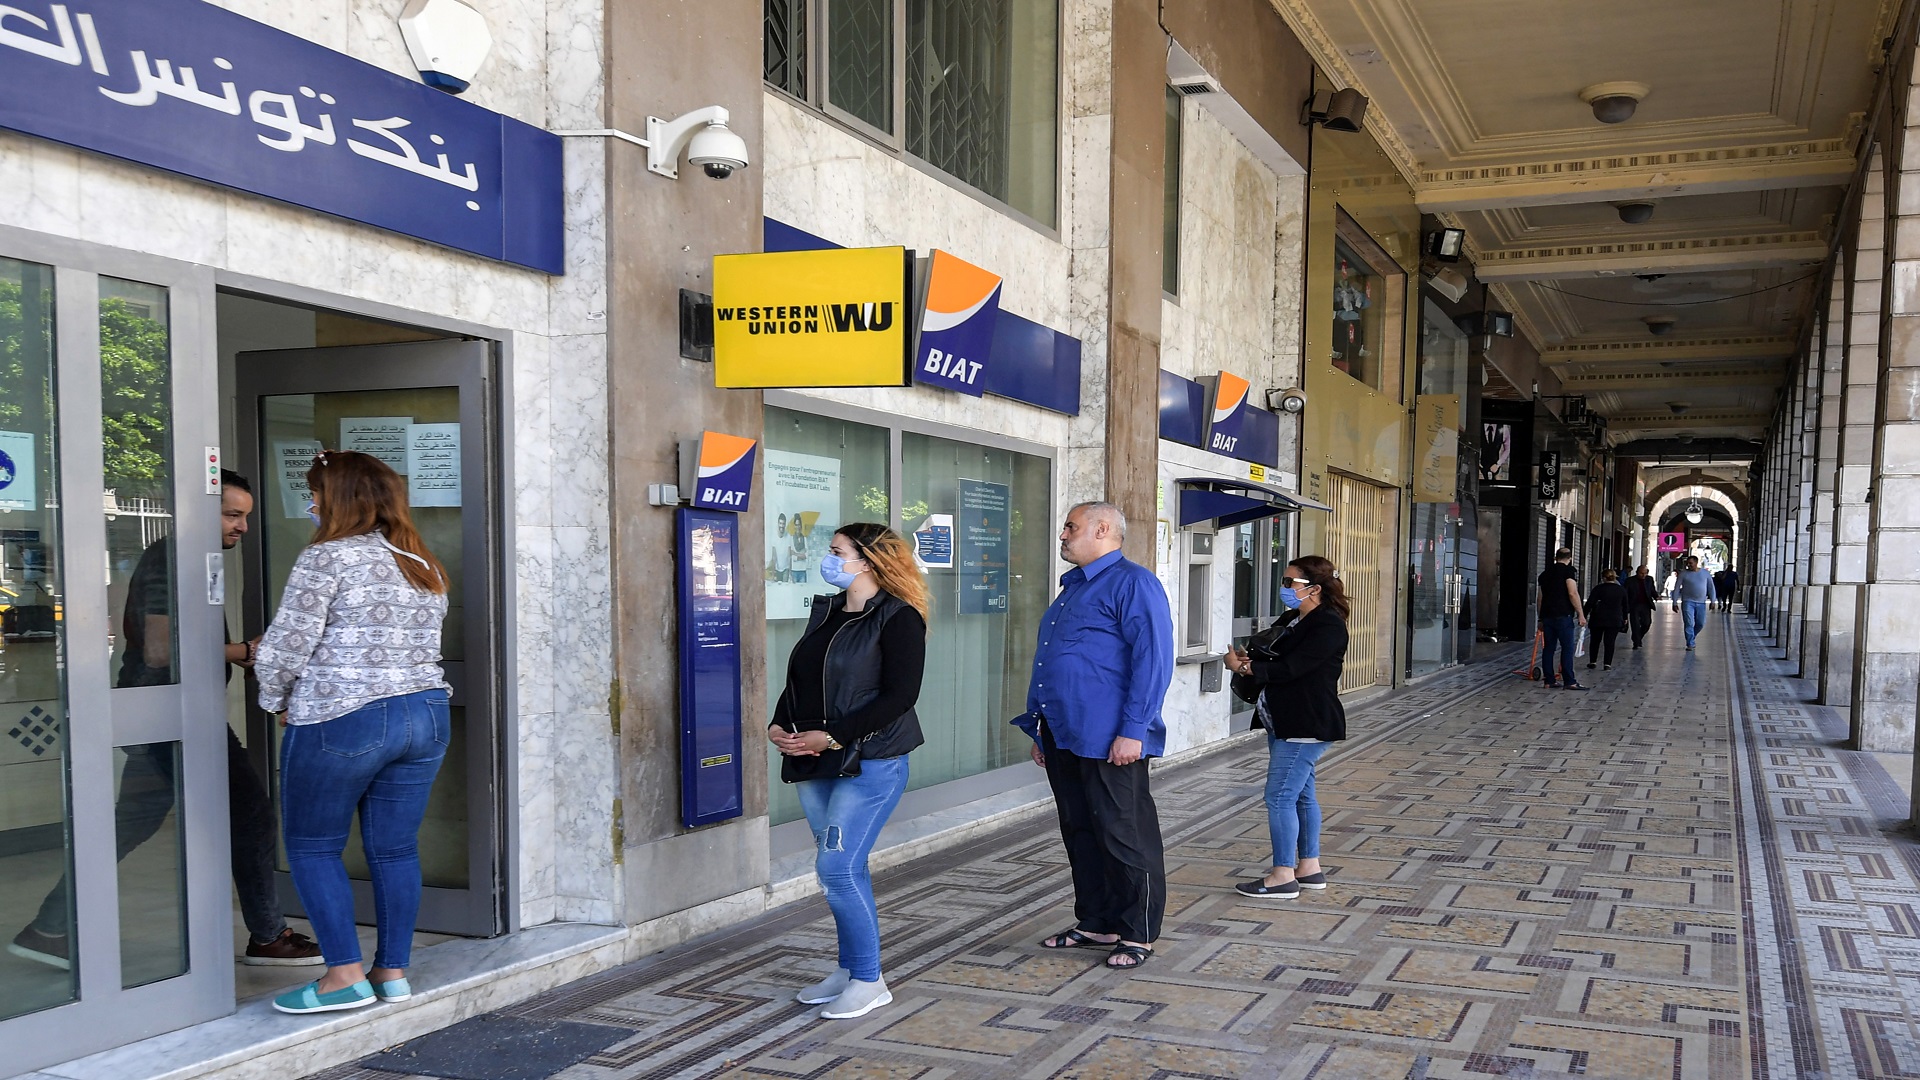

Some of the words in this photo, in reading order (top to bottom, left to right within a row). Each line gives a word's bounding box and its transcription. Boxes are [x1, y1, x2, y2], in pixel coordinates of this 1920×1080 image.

[98, 50, 338, 152] تونس
[347, 116, 480, 212] بنك
[717, 305, 818, 321] WESTERN
[831, 302, 893, 332] WU
[748, 320, 818, 335] UNION
[923, 347, 983, 385] BIAT
[1211, 432, 1238, 453] BIAT
[283, 448, 297, 456] UNE
[298, 448, 319, 456] SEULE
[286, 471, 296, 479] AU
[296, 471, 308, 480] SE
[795, 473, 818, 482] Fondation
[701, 487, 746, 506] BIAT
[988, 598, 998, 606] BIAT
